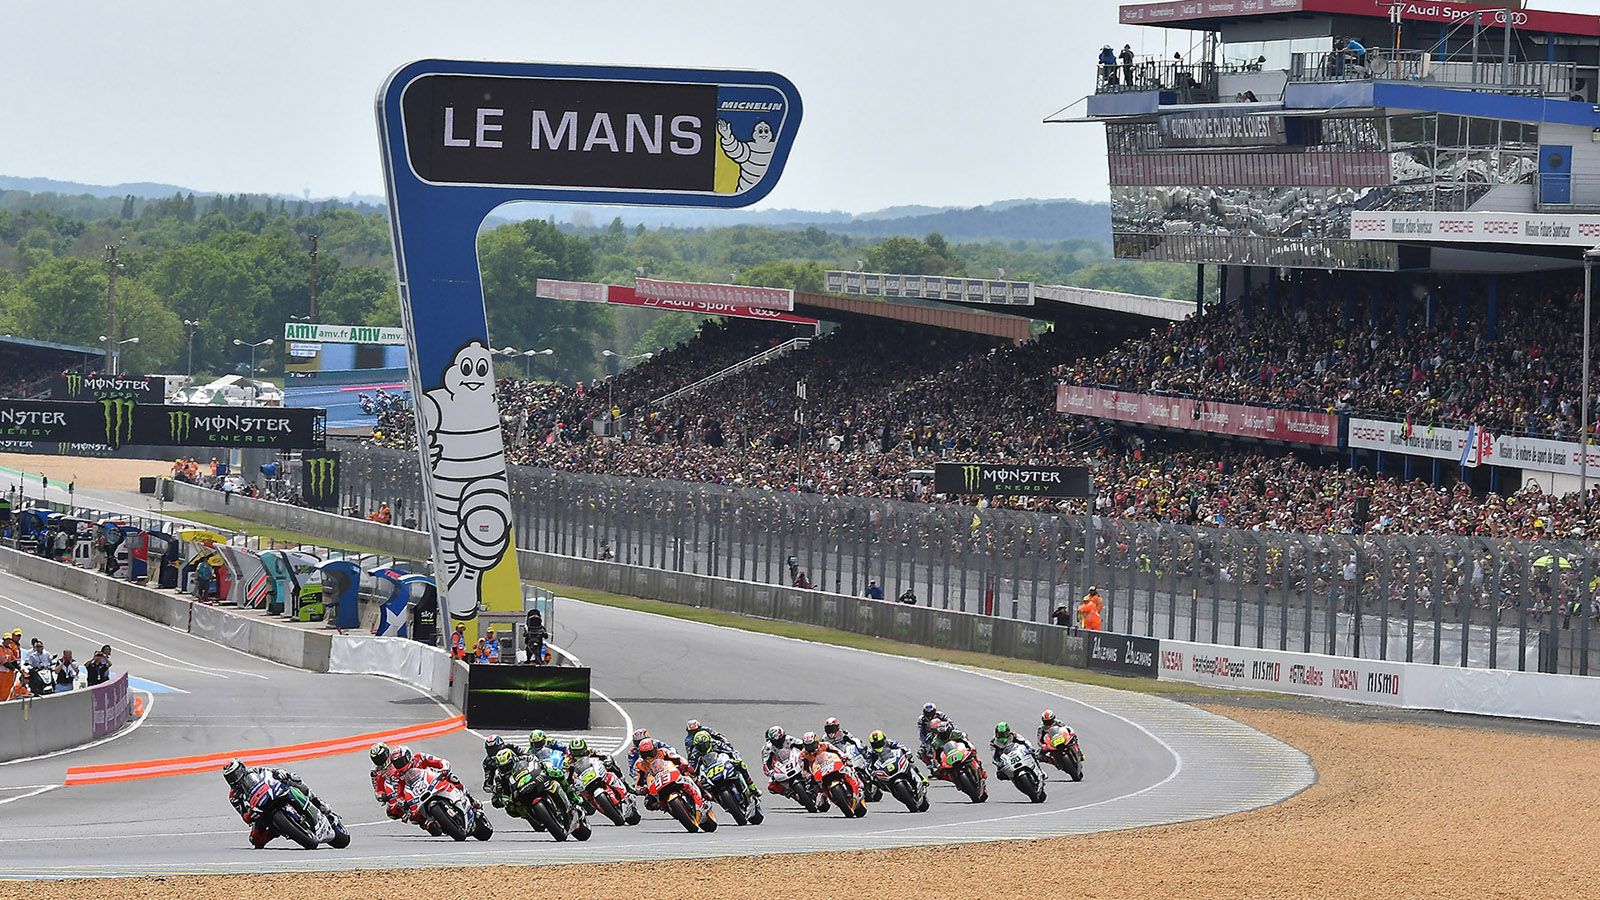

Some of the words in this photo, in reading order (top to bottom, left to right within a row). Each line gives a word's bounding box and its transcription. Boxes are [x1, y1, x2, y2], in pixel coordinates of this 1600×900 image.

[1407, 4, 1439, 16] Audi
[721, 101, 782, 111] MICHELIN
[443, 106, 504, 148] LE
[531, 110, 702, 157] MANS
[1214, 117, 1232, 138] CLUB
[1233, 117, 1243, 138] DE
[1579, 223, 1600, 237] PORS
[319, 330, 349, 338] amv.fr
[84, 378, 150, 391] MONSTER
[0, 408, 67, 426] NSTER
[194, 415, 292, 433] MONSTER
[209, 434, 278, 442] ENERGY
[983, 469, 1062, 483] MONSTER
[421, 610, 434, 619] sky
[1161, 650, 1183, 671] NISSAN
[1332, 669, 1358, 690] NISSAN
[706, 763, 725, 779] 46
[654, 771, 671, 791] 93
